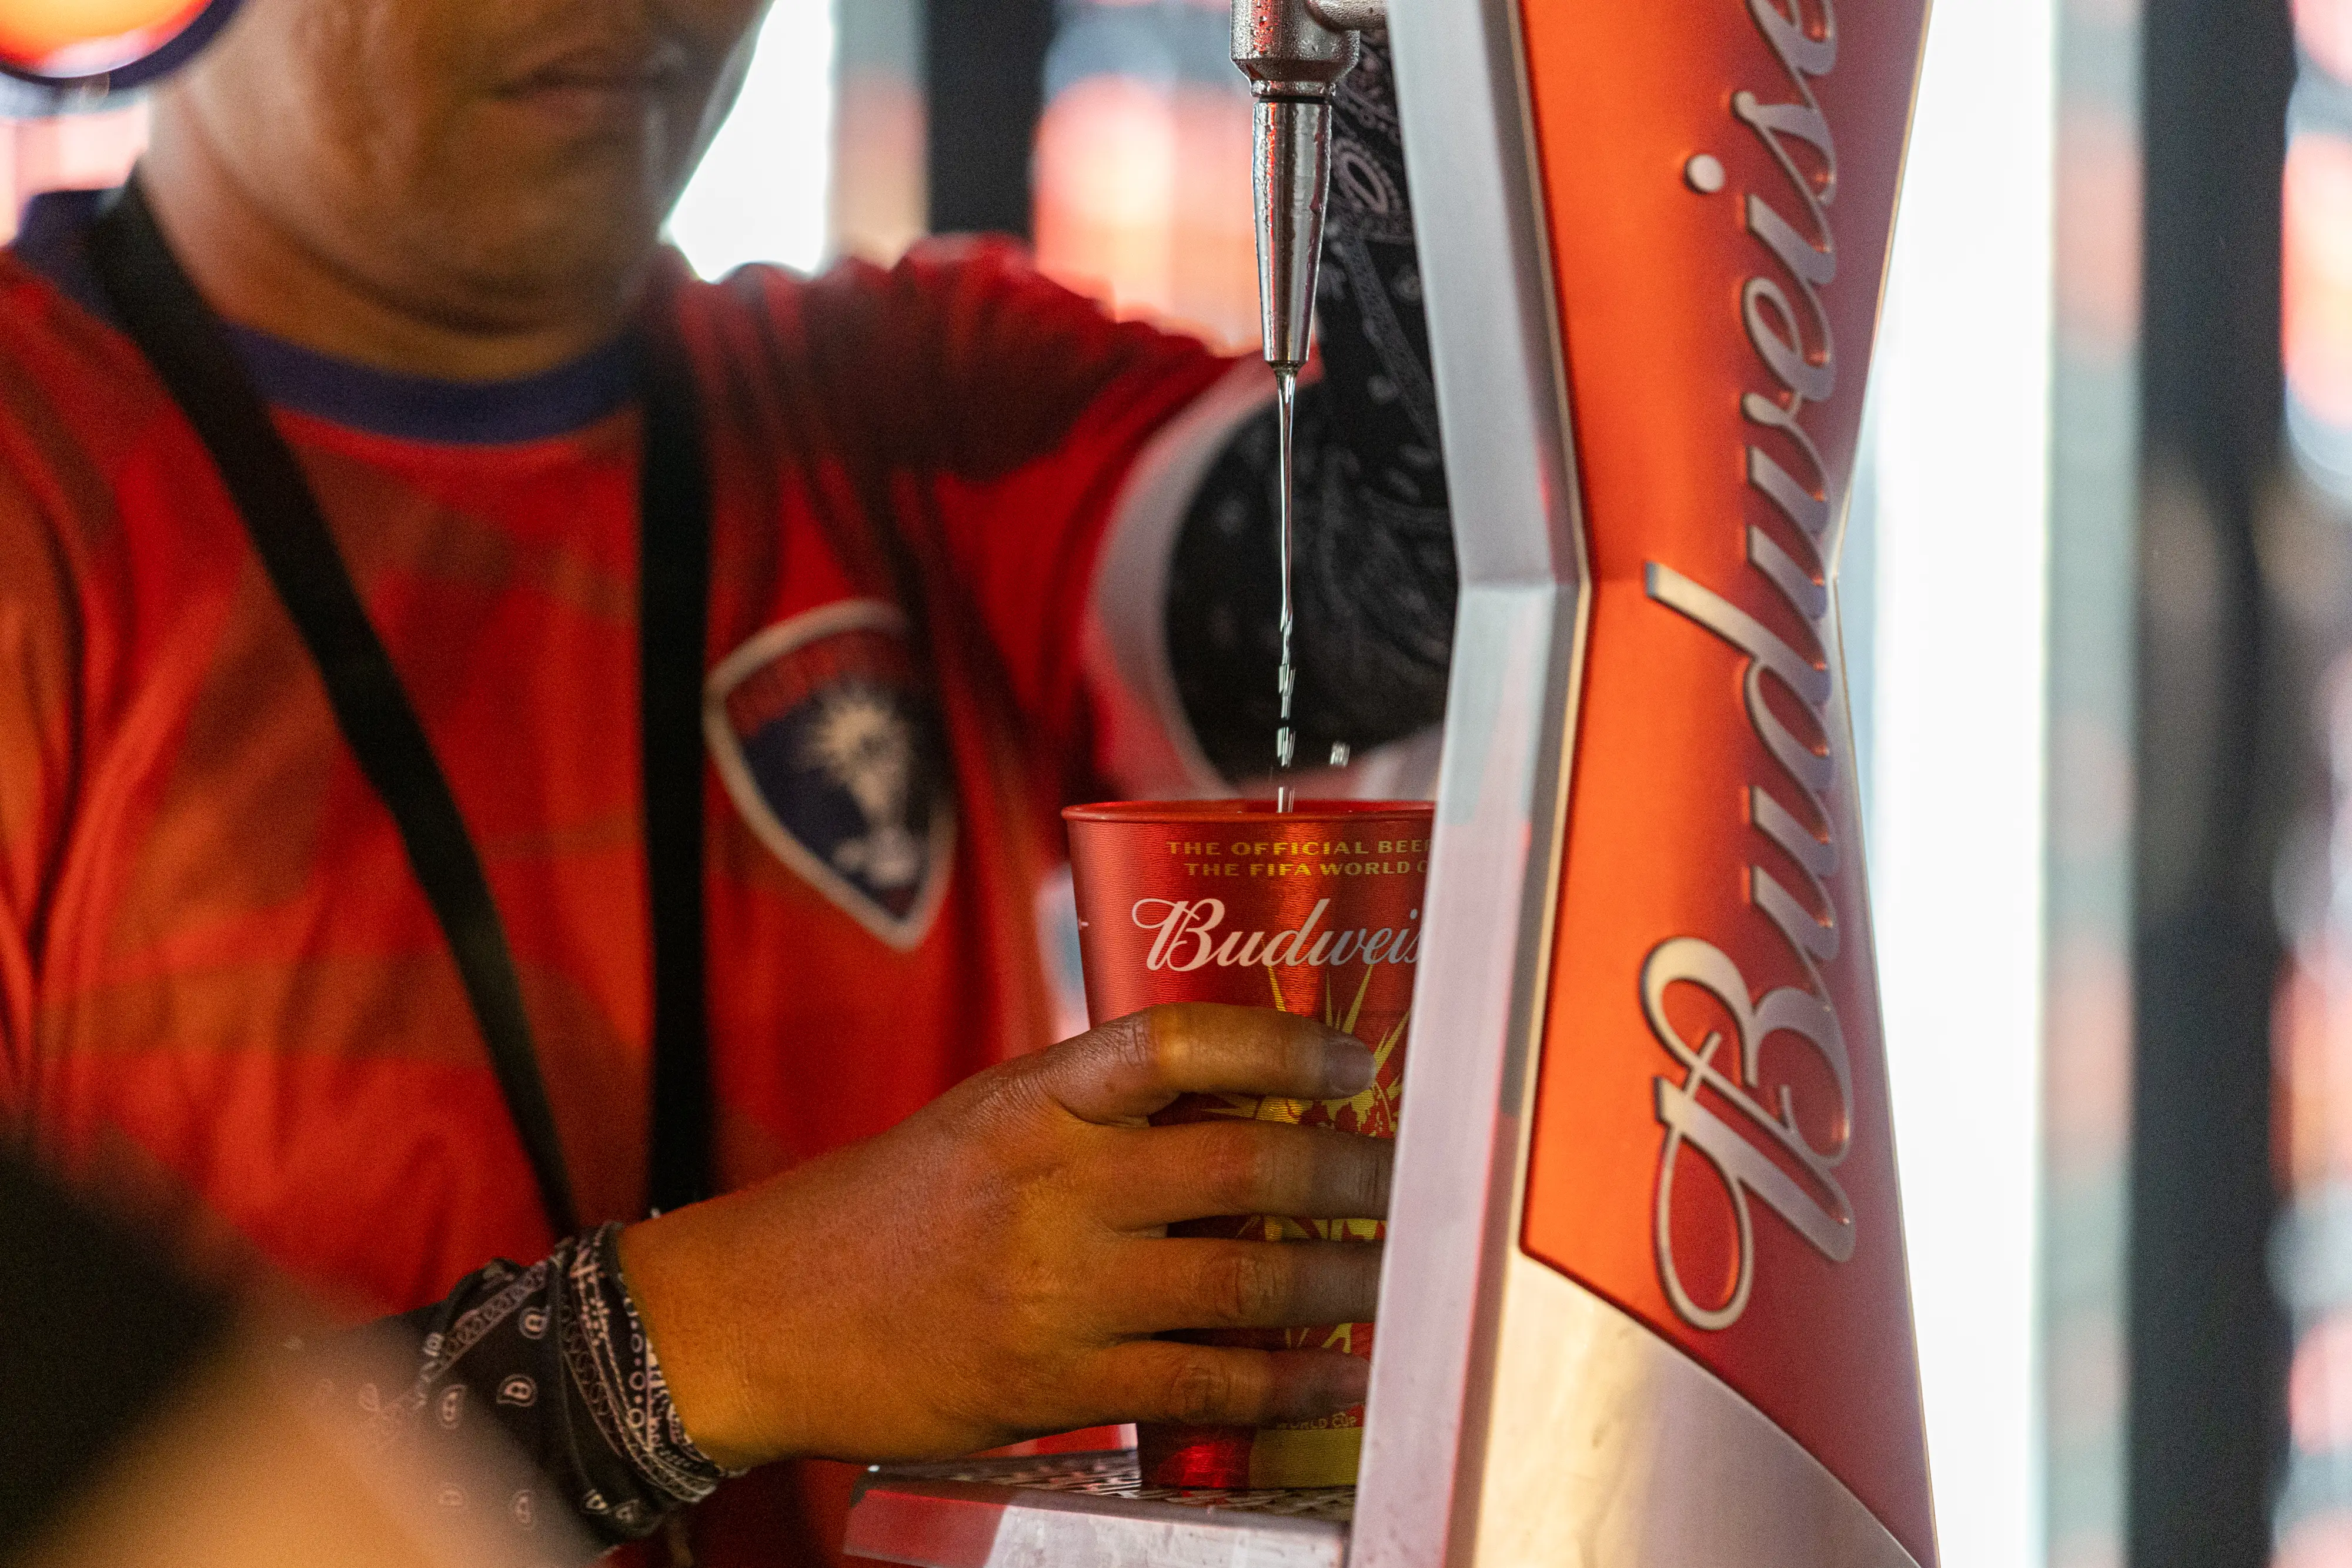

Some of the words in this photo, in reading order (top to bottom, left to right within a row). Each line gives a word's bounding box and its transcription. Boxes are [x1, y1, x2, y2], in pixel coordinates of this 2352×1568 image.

[1165, 841, 1221, 855] THE
[1231, 841, 1369, 855] OFFICIAL
[1184, 862, 1240, 876] THE
[1250, 862, 1311, 876] FIFA
[1319, 861, 1411, 875] WORLD
